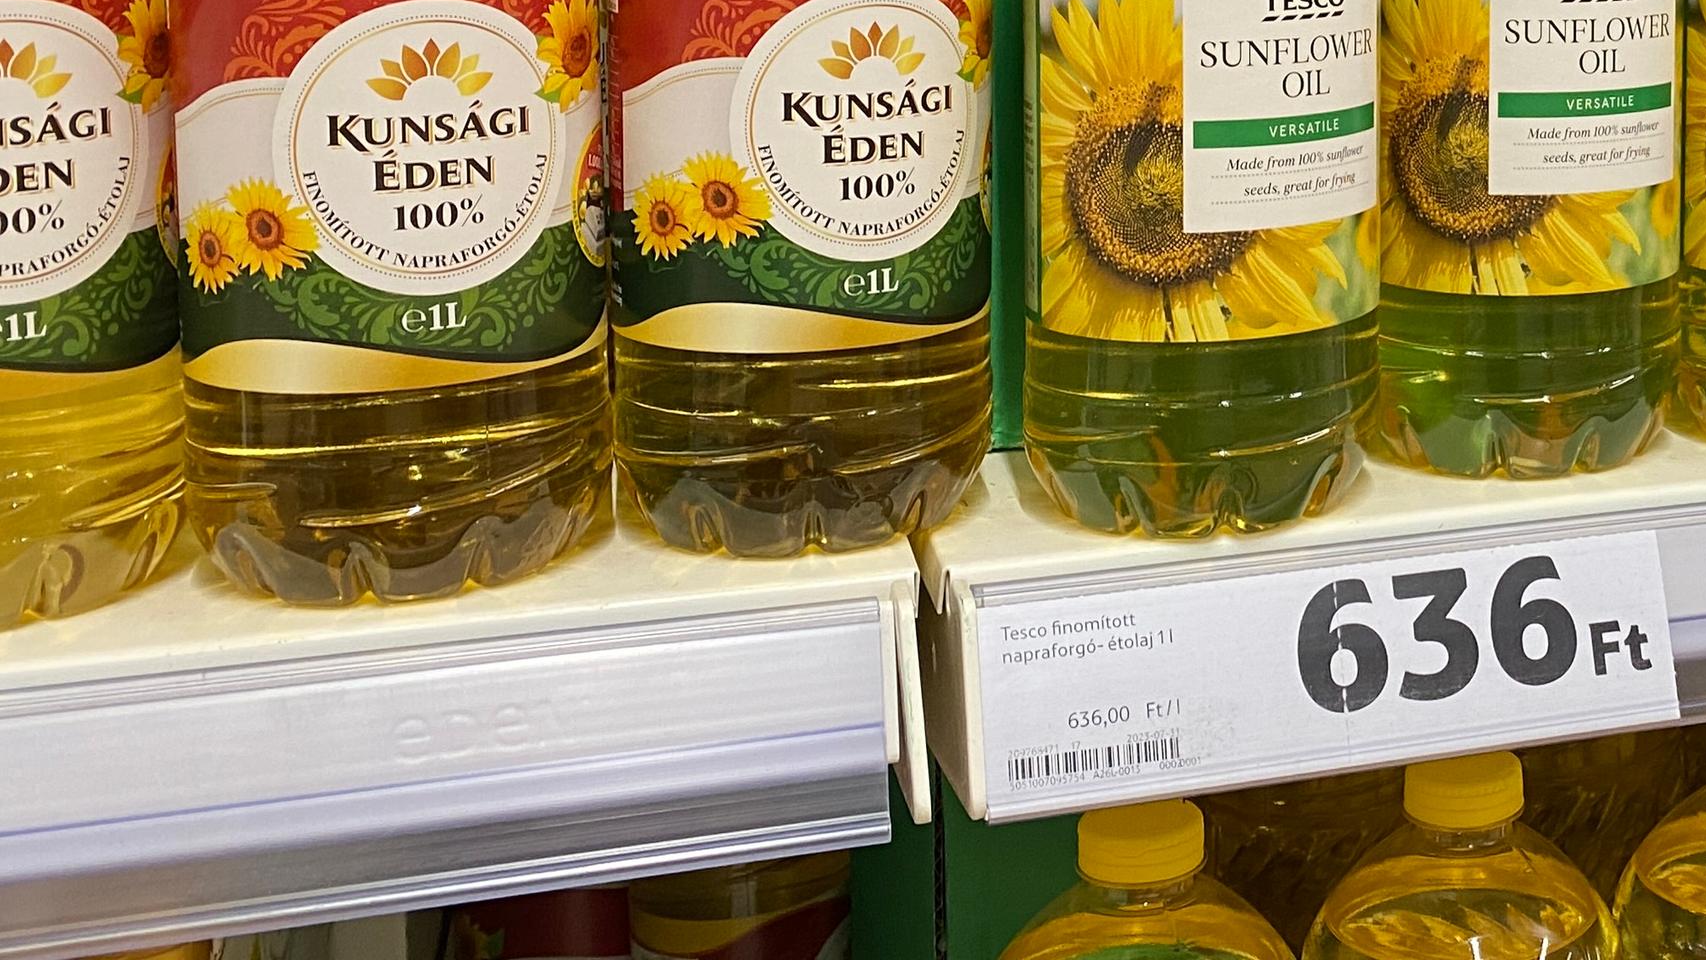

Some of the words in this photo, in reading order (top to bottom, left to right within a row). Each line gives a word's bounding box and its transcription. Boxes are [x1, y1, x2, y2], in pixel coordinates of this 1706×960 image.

[1504, 13, 1669, 44] SUNFLOWER
[1200, 28, 1372, 69] SUNFLOWER
[1579, 49, 1626, 75] OIL
[1282, 71, 1330, 98] OIL
[781, 79, 952, 127] KUNSÁGI
[1566, 95, 1634, 110] VERSATILE
[0, 102, 111, 146] SÁGI
[327, 99, 529, 154] KUNSÁGI
[1269, 118, 1339, 138] VERSATILE
[1527, 128, 1560, 140] Made
[1562, 126, 1590, 142] from
[1593, 124, 1618, 138] 100%
[1621, 120, 1659, 135] sunflower
[823, 125, 924, 164] ÉDEN
[1227, 157, 1263, 171] Made
[1265, 154, 1295, 171] from
[1298, 151, 1324, 167] 100%
[1326, 144, 1363, 164] sunflower
[1543, 152, 1577, 164] seeds,
[1579, 150, 1607, 165] great
[1608, 148, 1624, 162] for
[1625, 145, 1651, 160] frying
[0, 158, 73, 193] EN
[374, 150, 495, 191] ÉDEN
[758, 145, 835, 229] FINOMÍTOTT
[841, 167, 915, 201] 100%
[1244, 182, 1280, 197] seeds,
[1283, 178, 1313, 196] great
[1314, 176, 1330, 193] for
[1330, 173, 1355, 191] frying
[0, 200, 65, 235] 0%
[303, 171, 390, 261] FINOMÍTOTT
[394, 194, 484, 231] 100%
[0, 311, 47, 341] 1L
[1001, 626, 1047, 641] Tesco
[1052, 613, 1136, 635] finomított
[1297, 555, 1577, 713] 636
[1589, 620, 1652, 677] Ft
[1002, 640, 1103, 665] napraforgó-
[1108, 633, 1153, 650] étolaj
[1068, 706, 1130, 728] 636,00
